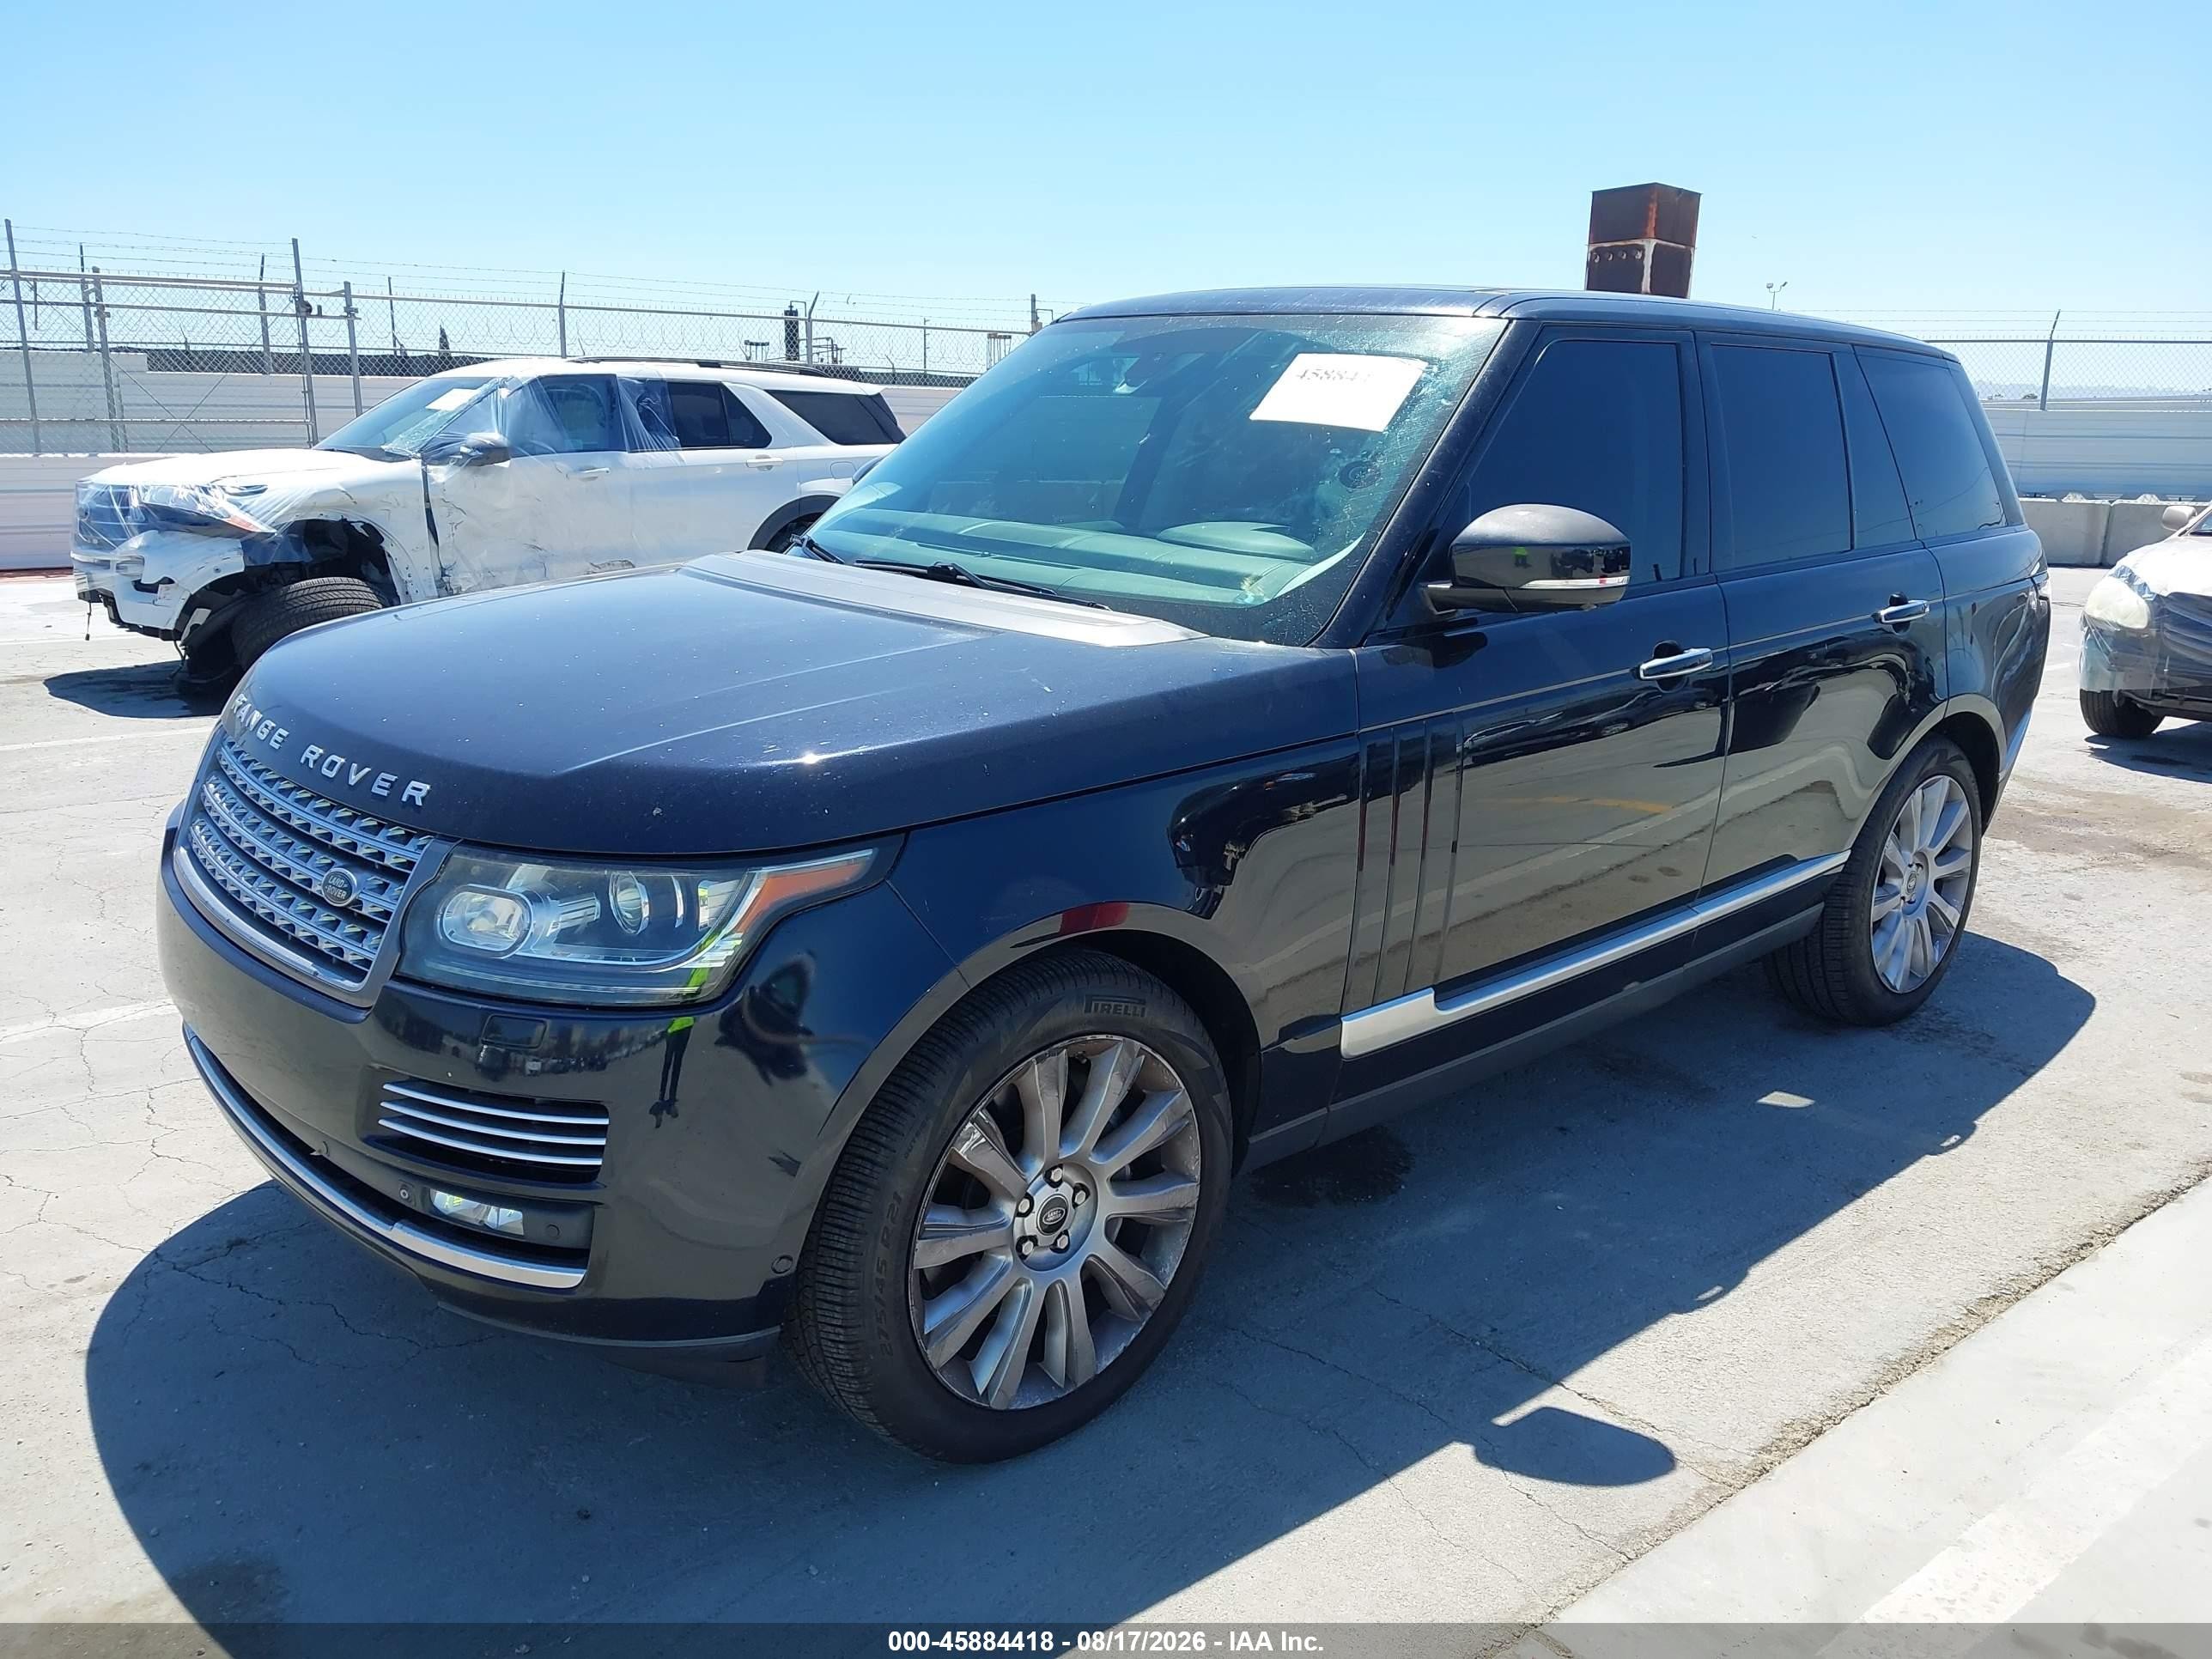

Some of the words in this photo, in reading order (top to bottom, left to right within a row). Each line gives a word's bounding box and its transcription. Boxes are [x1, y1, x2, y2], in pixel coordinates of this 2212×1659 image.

[231, 693, 289, 750] RANGE
[300, 744, 432, 806] ROVER
[326, 885, 347, 899] ROVER
[1084, 994, 1146, 1017] PIRELLI
